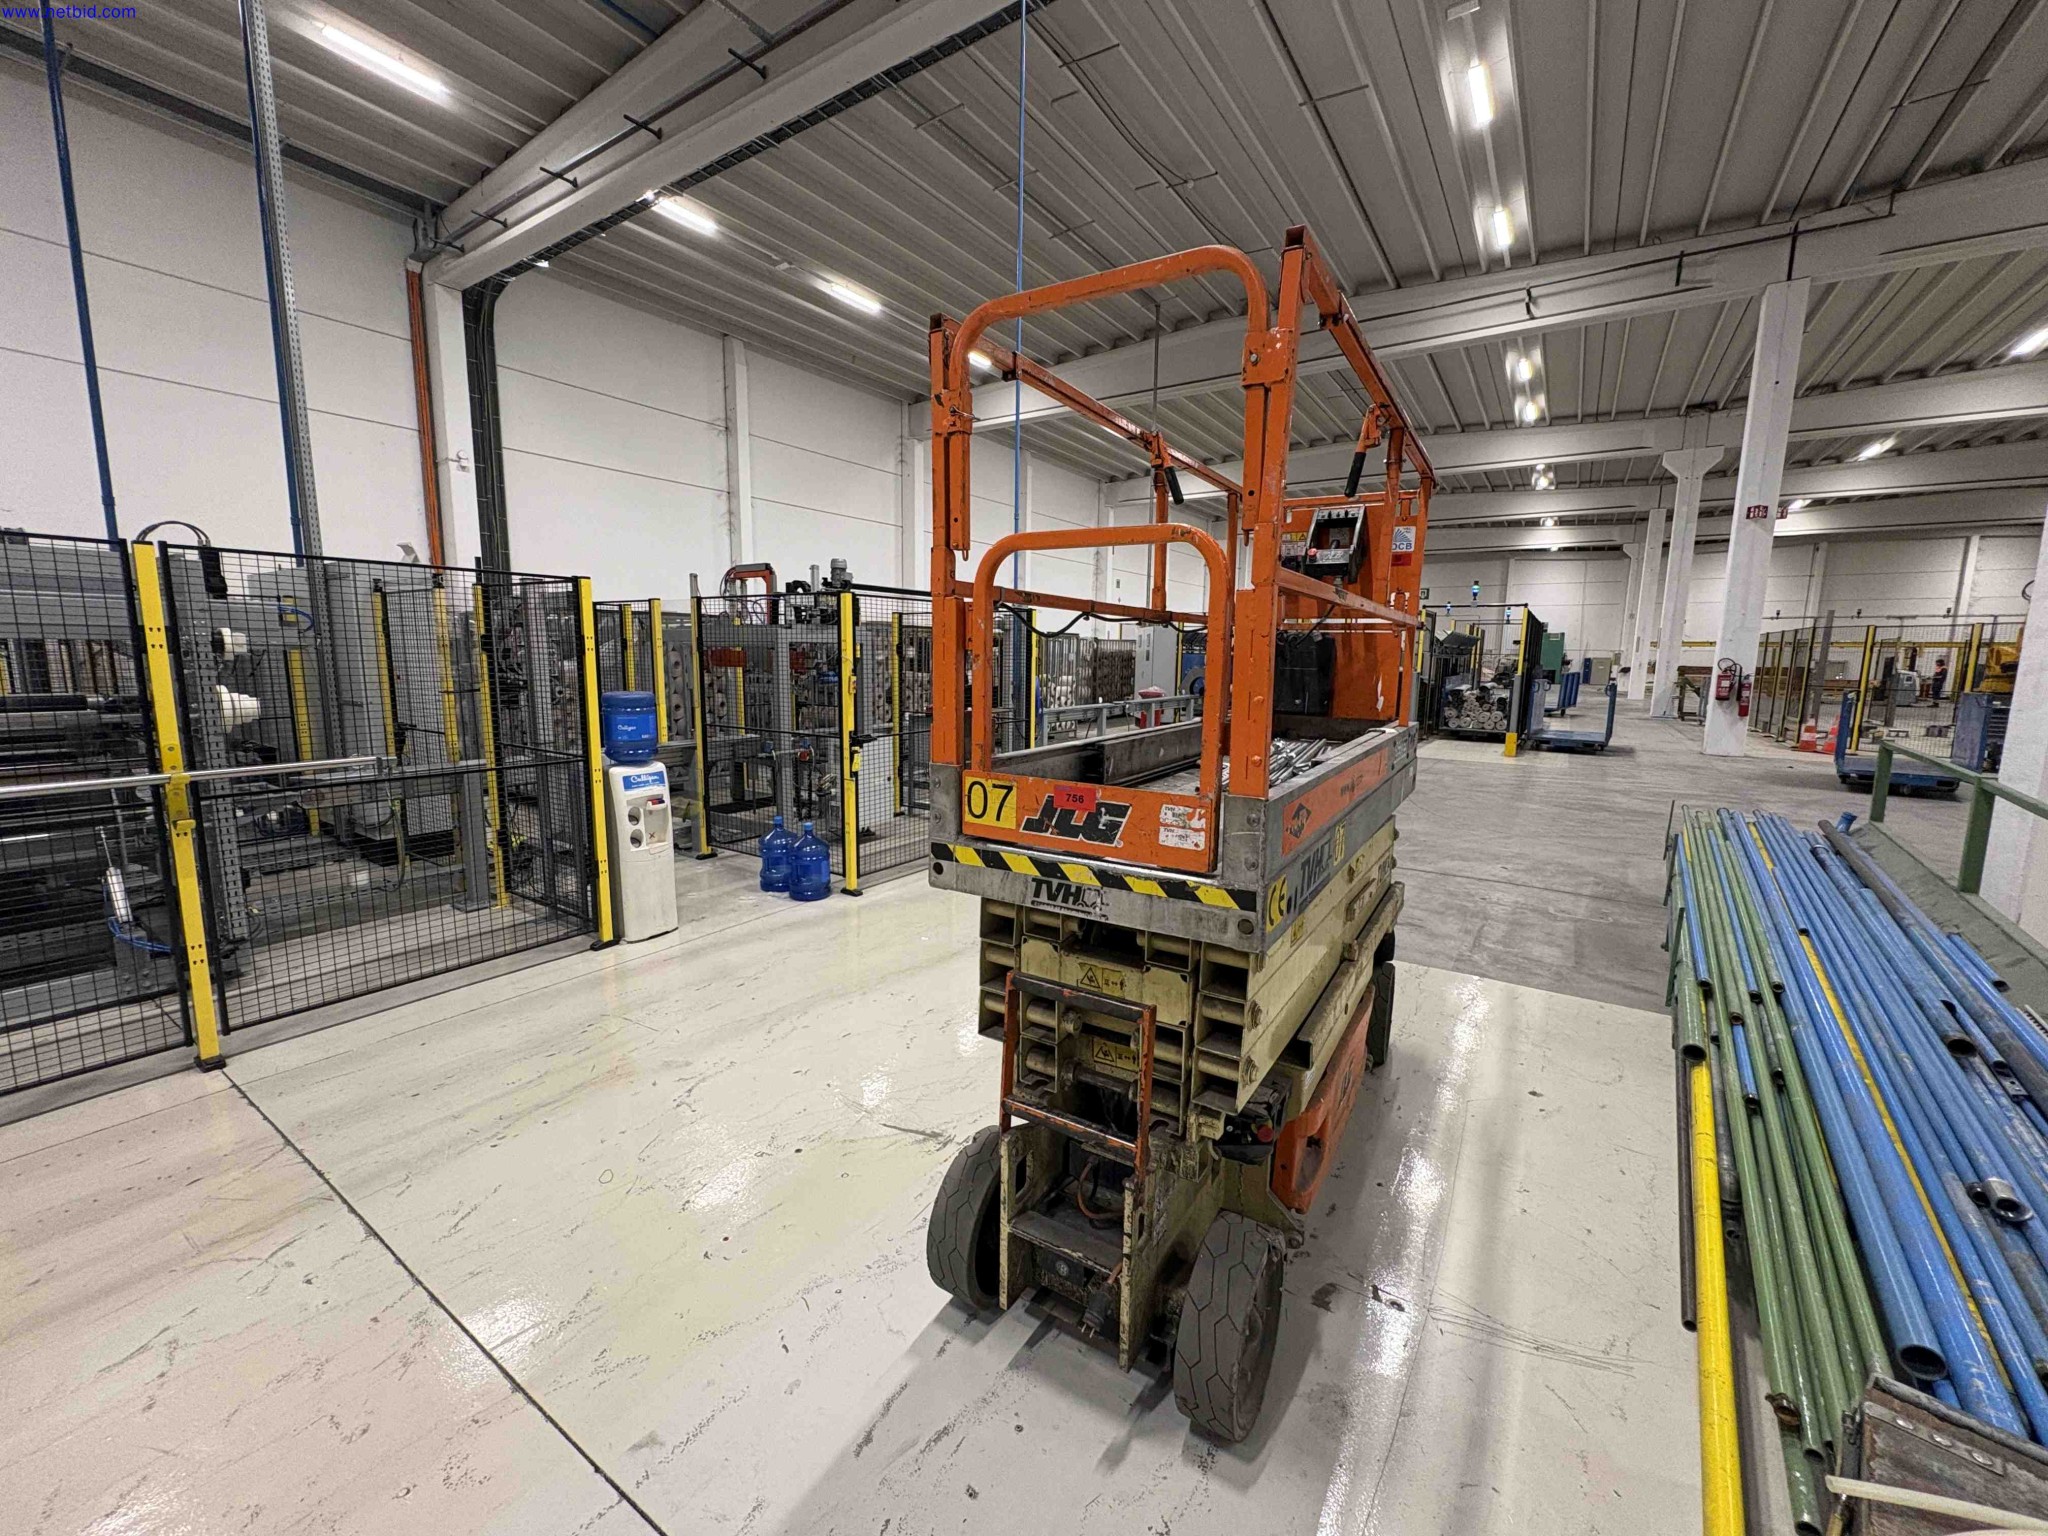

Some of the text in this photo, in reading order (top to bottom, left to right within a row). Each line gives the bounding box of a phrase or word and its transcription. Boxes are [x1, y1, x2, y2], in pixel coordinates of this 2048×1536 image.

[966, 780, 1014, 822] 07
[1065, 793, 1085, 804] 756
[1031, 877, 1082, 906] TVH
